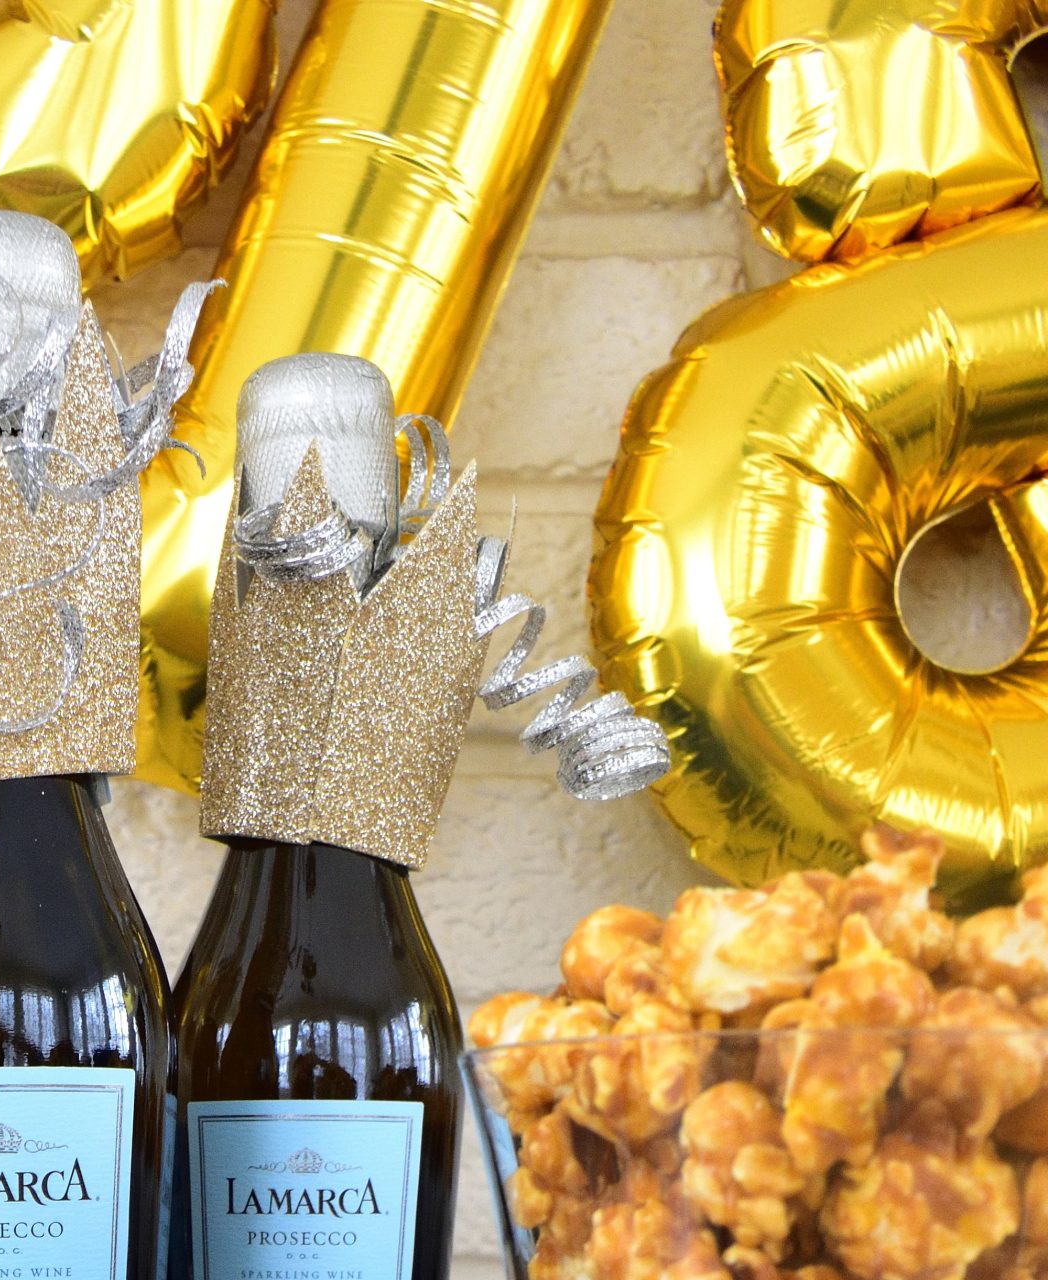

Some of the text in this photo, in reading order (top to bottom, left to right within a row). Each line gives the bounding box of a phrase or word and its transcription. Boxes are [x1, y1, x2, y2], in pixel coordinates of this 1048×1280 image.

[247, 1231, 357, 1246] PROSECCO
[30, 1267, 72, 1278] WINE
[240, 1270, 364, 1280] SPARKLING WINE
